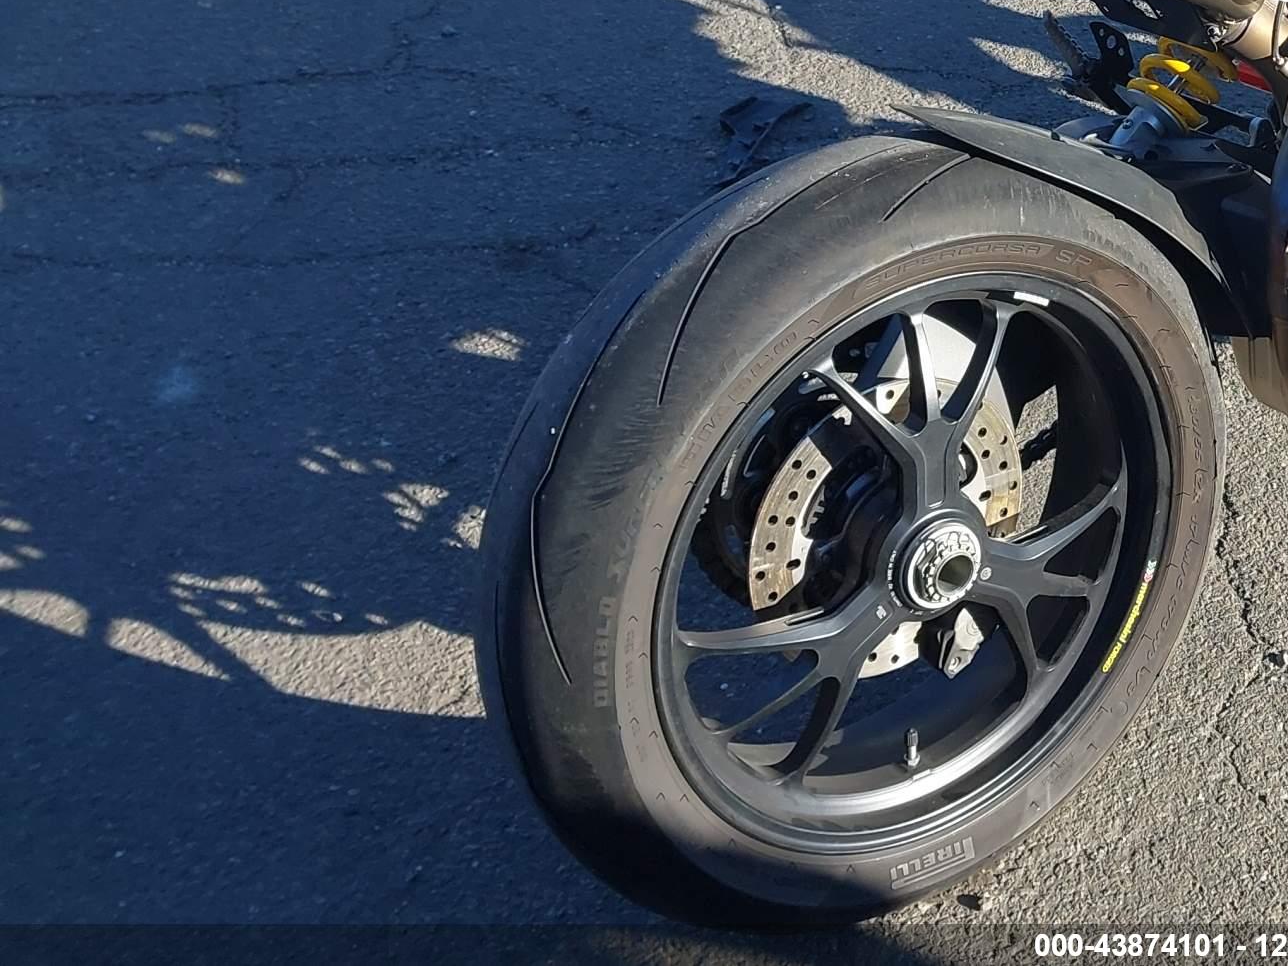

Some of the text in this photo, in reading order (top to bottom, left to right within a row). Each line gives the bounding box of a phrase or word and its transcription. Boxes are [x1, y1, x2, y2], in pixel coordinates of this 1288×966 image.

[863, 242, 1093, 290] SUPERCORSA SP
[592, 596, 617, 710] DIABLO
[889, 836, 976, 891] PIRELLI
